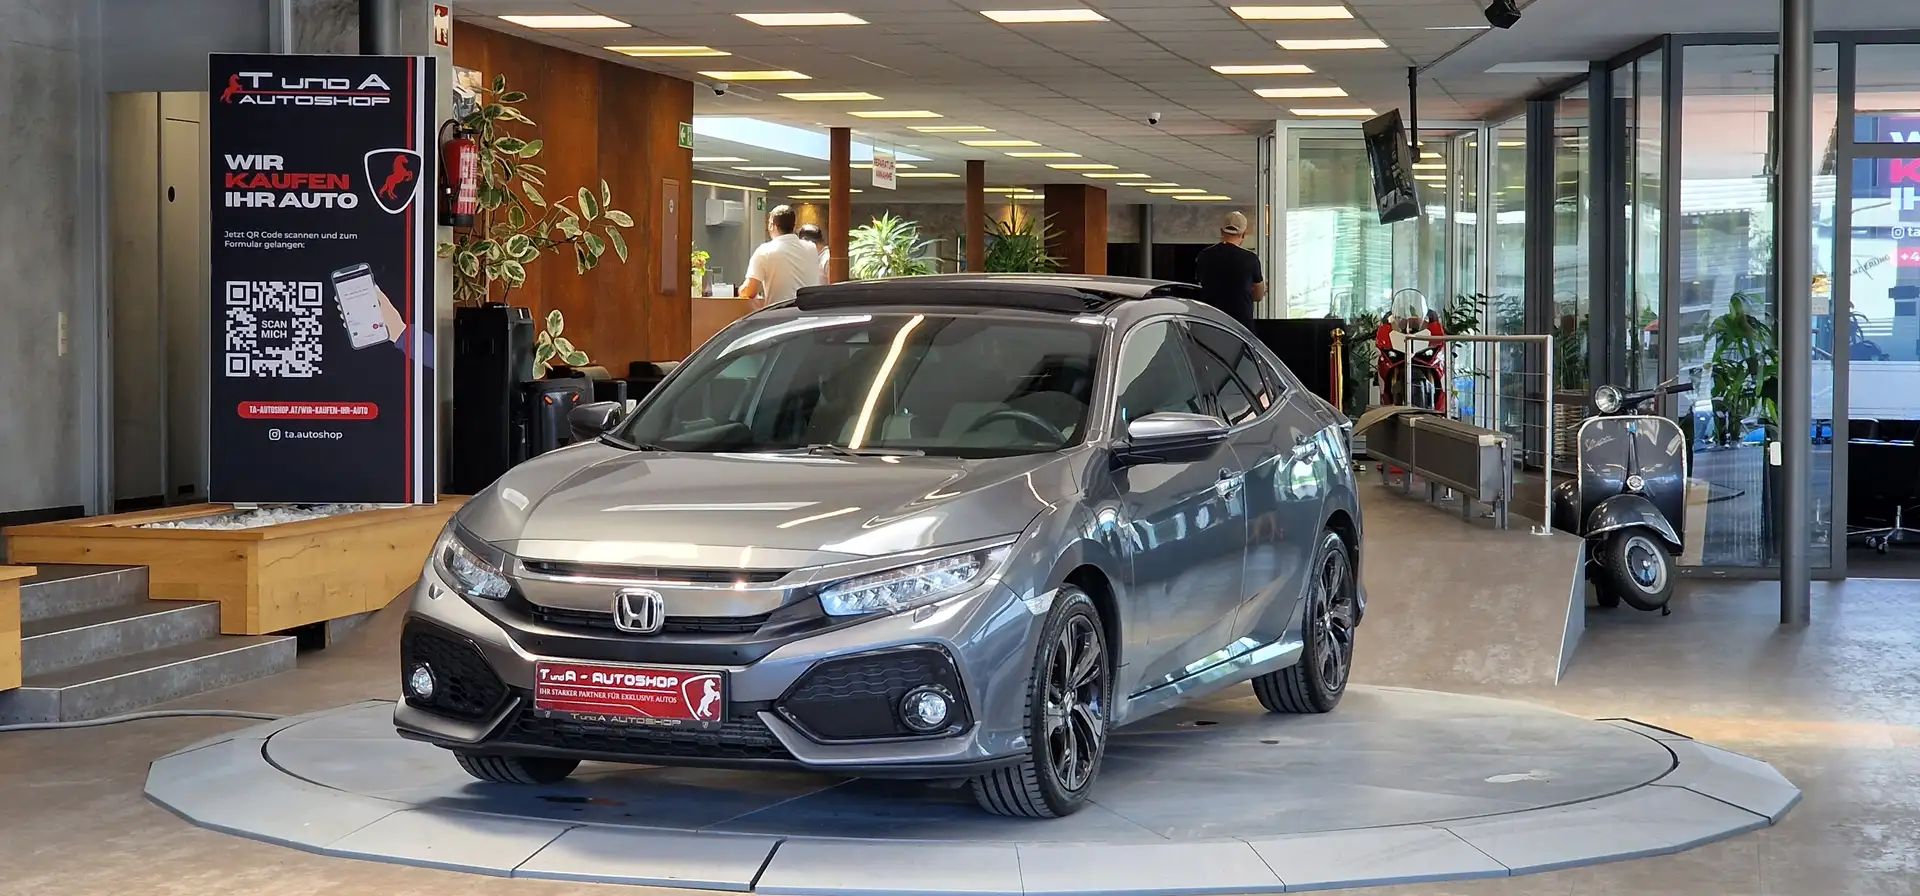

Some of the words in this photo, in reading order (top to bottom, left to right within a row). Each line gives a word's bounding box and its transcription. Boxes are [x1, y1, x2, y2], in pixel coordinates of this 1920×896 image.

[239, 72, 273, 88] T
[357, 73, 391, 91] A
[239, 95, 391, 107] AUTOSHOP
[224, 154, 284, 171] WIR
[225, 173, 350, 190] KAUFEN
[225, 191, 276, 208] IHR
[278, 192, 359, 209] AUTO
[224, 231, 245, 239] Jetzt
[246, 231, 259, 239] QR
[261, 231, 283, 239] Code
[284, 232, 320, 240] scannen
[321, 232, 338, 240] und
[224, 240, 263, 248] Formular
[264, 241, 306, 250] gelangen:
[261, 320, 288, 329] SCAN
[261, 330, 288, 339] MICH
[284, 430, 343, 440] ta.autoshop
[539, 668, 551, 680] T
[565, 670, 577, 682] A
[592, 672, 679, 688] AUTOSHOP
[578, 691, 607, 699] PARTNER
[607, 692, 621, 700] FÜR
[621, 694, 655, 702] EXKLUSIVE
[655, 696, 677, 704] AUTOS
[610, 715, 682, 727] AUTOSHOP
